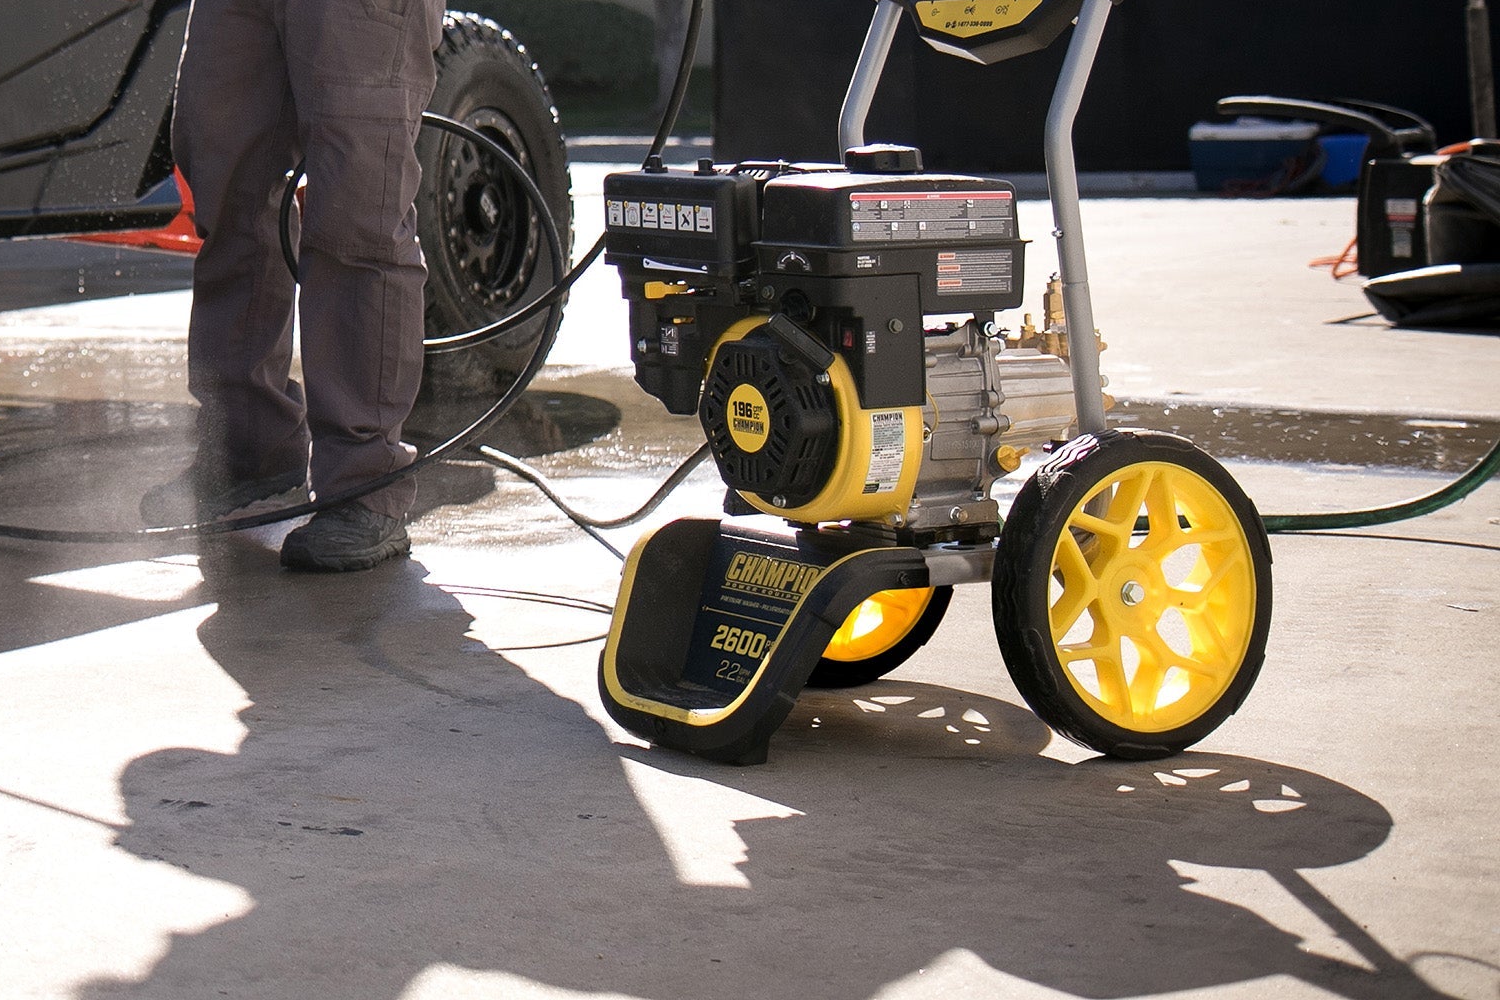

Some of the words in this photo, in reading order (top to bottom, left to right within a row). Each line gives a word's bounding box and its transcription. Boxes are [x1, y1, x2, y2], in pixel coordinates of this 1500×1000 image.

[733, 400, 753, 419] 196
[872, 412, 903, 423] CHAMPION
[726, 552, 825, 594] CHAMPIO
[724, 581, 758, 593] POWER
[710, 624, 767, 659] 2600
